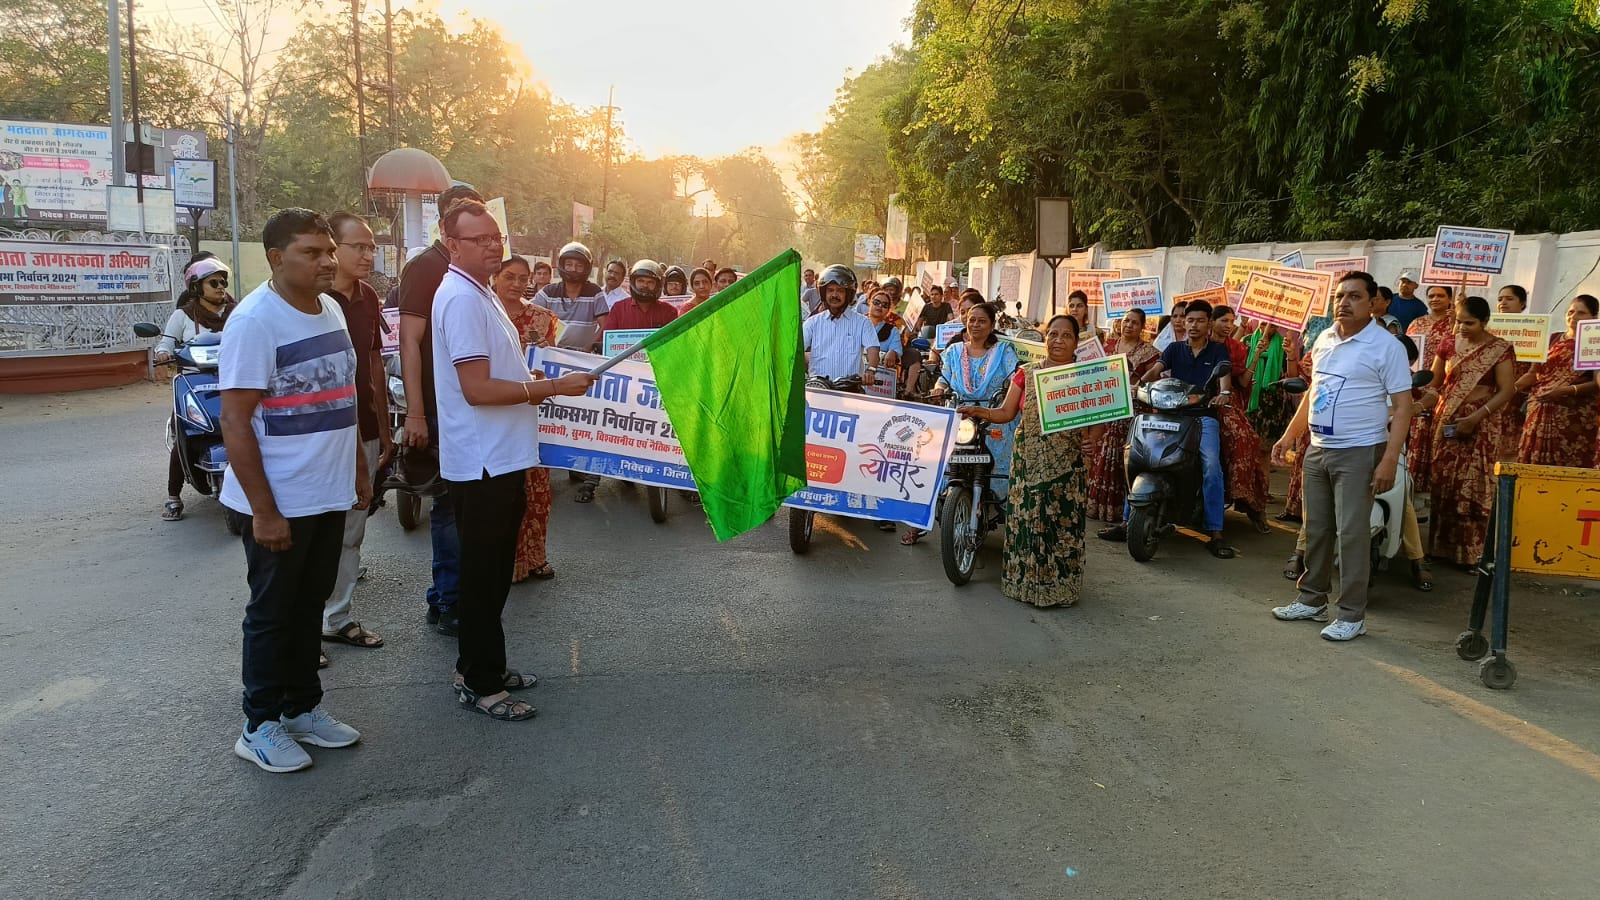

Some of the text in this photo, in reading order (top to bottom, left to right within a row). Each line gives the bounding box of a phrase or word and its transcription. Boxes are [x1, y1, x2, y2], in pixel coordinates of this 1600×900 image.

[109, 250, 150, 268] अभियान
[17, 270, 50, 282] निर्वाचन
[52, 273, 77, 283] 2024
[1046, 388, 1066, 401] लालच
[1068, 385, 1081, 396] देकर
[1082, 381, 1093, 393] वोट
[1094, 379, 1103, 391] जो
[1080, 396, 1097, 409] करेगा
[601, 407, 657, 436] निर्वाचन
[911, 416, 927, 429] 2024
[571, 428, 593, 442] सुगम,
[596, 431, 634, 449] विश्वसनीय
[636, 439, 647, 451] एवं
[649, 440, 670, 455] नैतिक
[887, 450, 912, 461] MAHA
[906, 446, 914, 454] KA
[619, 458, 653, 475] निवेदक
[662, 465, 691, 482] जिला
